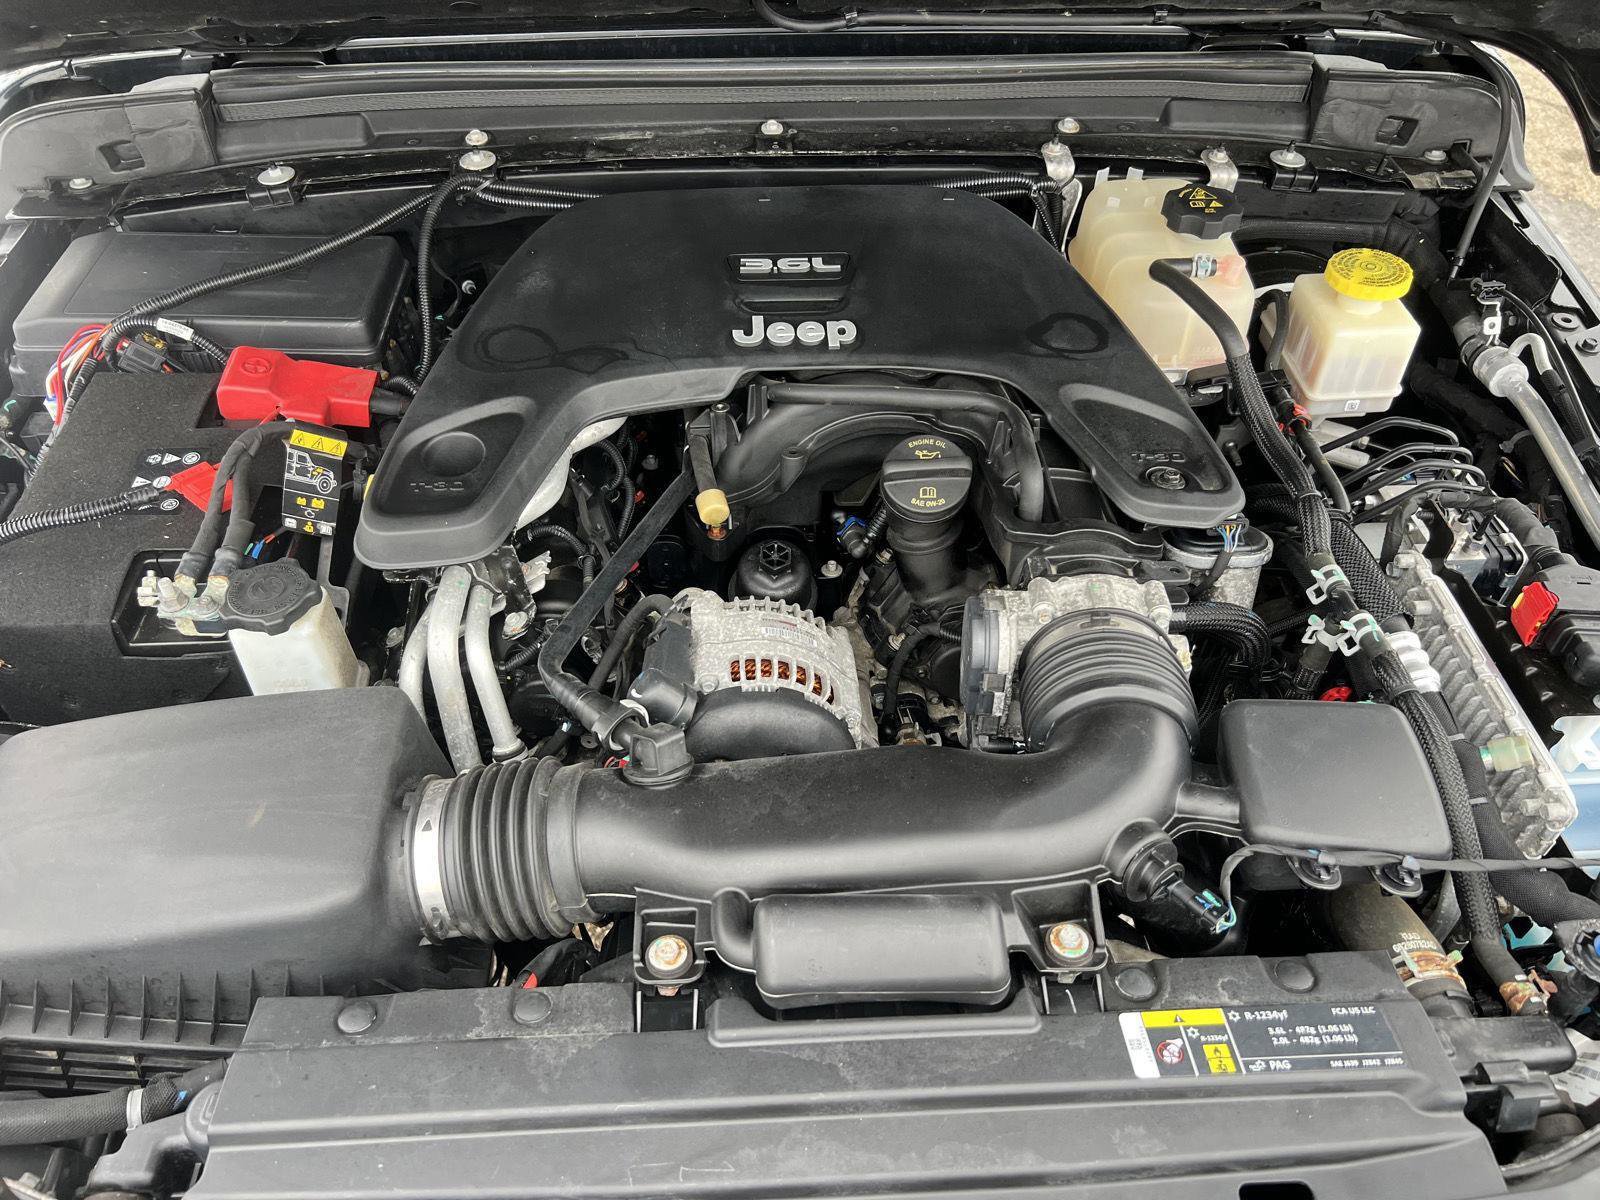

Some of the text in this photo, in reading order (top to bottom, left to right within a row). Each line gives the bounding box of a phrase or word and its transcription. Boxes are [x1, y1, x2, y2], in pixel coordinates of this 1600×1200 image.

[740, 257, 841, 274] 3.6L
[732, 315, 857, 350] Jeep
[907, 438, 947, 449] ENGINE OIL
[1130, 451, 1186, 463] T-30
[910, 497, 946, 507] SAE 0W-20
[1244, 1009, 1289, 1022] R-1234yf
[1331, 1006, 1376, 1016] FCA US LLC
[1267, 1027, 1287, 1036] 3.6L
[1272, 1037, 1291, 1046] 2.0L
[1269, 1060, 1292, 1071] PAG
